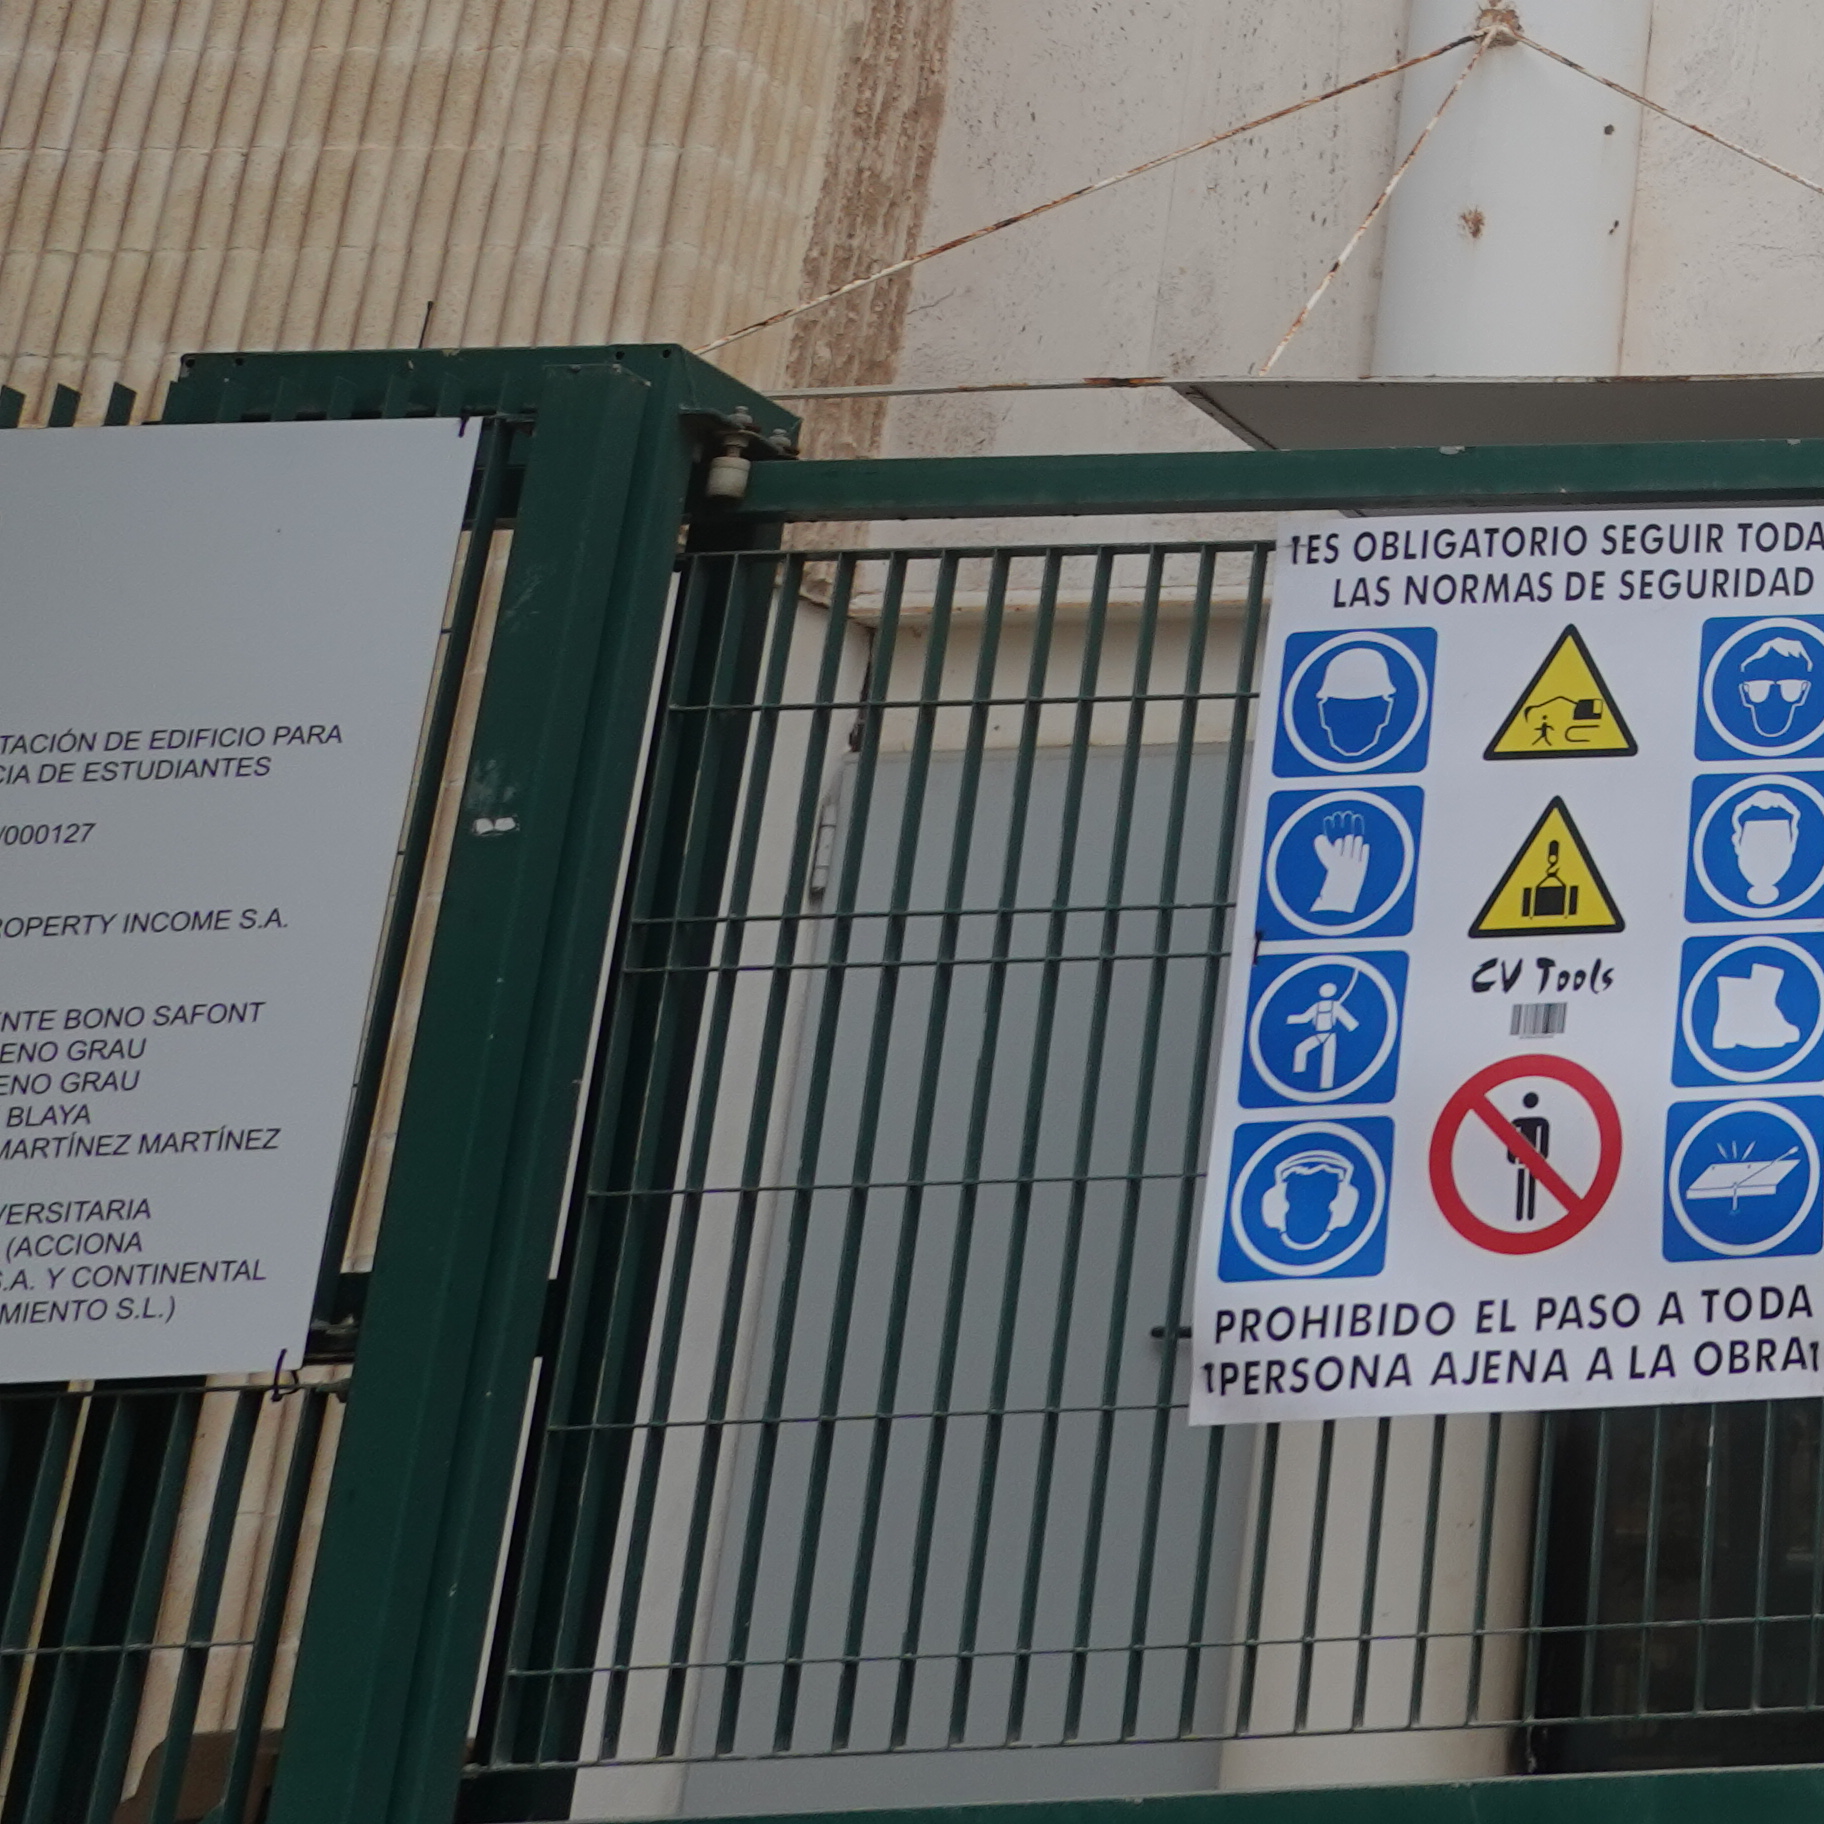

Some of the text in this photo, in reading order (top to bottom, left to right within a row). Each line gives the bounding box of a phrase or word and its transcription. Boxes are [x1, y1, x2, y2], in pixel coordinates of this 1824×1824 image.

[1353, 524, 1588, 563] OBLIGATORIO
[1601, 523, 1724, 555] SEGUIR
[1333, 566, 1815, 608] LAS NORMAS DE SEGURIDAD
[104, 731, 142, 752] DE
[149, 726, 265, 750] EDIFICIO
[273, 725, 343, 746] PARA
[38, 763, 76, 784] DE
[83, 756, 272, 783] ESTUDIANTES
[0, 908, 288, 938] OPERTY INCOME S.A.
[1471, 956, 1615, 995] CV Tools
[63, 1006, 145, 1030] BONO
[152, 1001, 266, 1026] SAFONT
[67, 1038, 146, 1061] GRAU
[60, 1070, 140, 1093] GRAU
[7, 1104, 91, 1127] BLAYA
[137, 1125, 281, 1155] MARTÍNEZ
[6, 1231, 143, 1264] (ACCIONA
[47, 1267, 66, 1289] Y
[72, 1258, 267, 1288] CONTINENTAL
[116, 1295, 176, 1324] S.L.)
[1215, 1284, 1813, 1344] PROHIBIDO EL PASO A TODA
[1430, 1348, 1569, 1386] AJENA
[1586, 1346, 1614, 1382] A
[1629, 1344, 1677, 1380] LA
